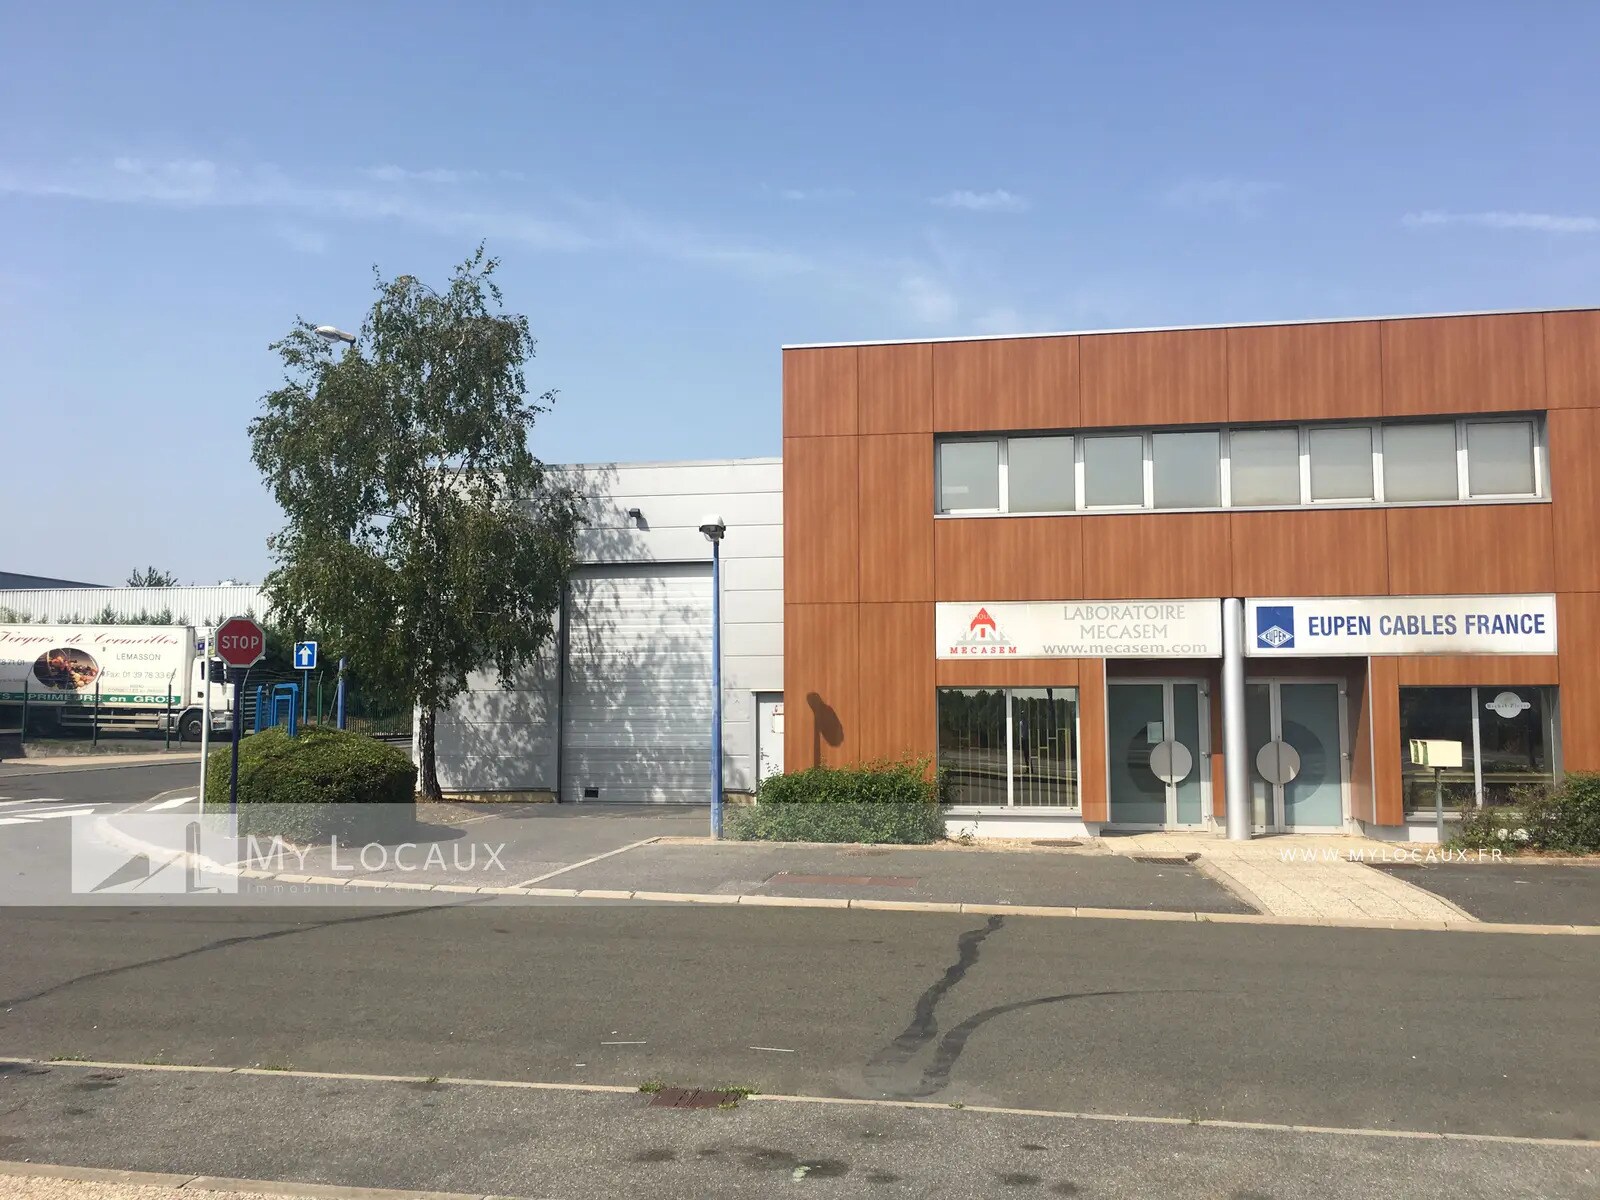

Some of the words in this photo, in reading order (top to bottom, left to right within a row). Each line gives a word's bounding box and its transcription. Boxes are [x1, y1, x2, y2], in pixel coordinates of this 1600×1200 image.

[1063, 605, 1186, 621] LABORATOIRE
[1080, 624, 1168, 640] MECASEM
[1308, 616, 1372, 636] EUPEN
[1379, 615, 1458, 635] CABLES
[1465, 613, 1546, 634] FRANCE
[221, 635, 260, 650] STOP
[950, 646, 1017, 654] MECASEM
[1043, 642, 1208, 655] www.mecasem.com
[116, 652, 161, 661] LEMASSON
